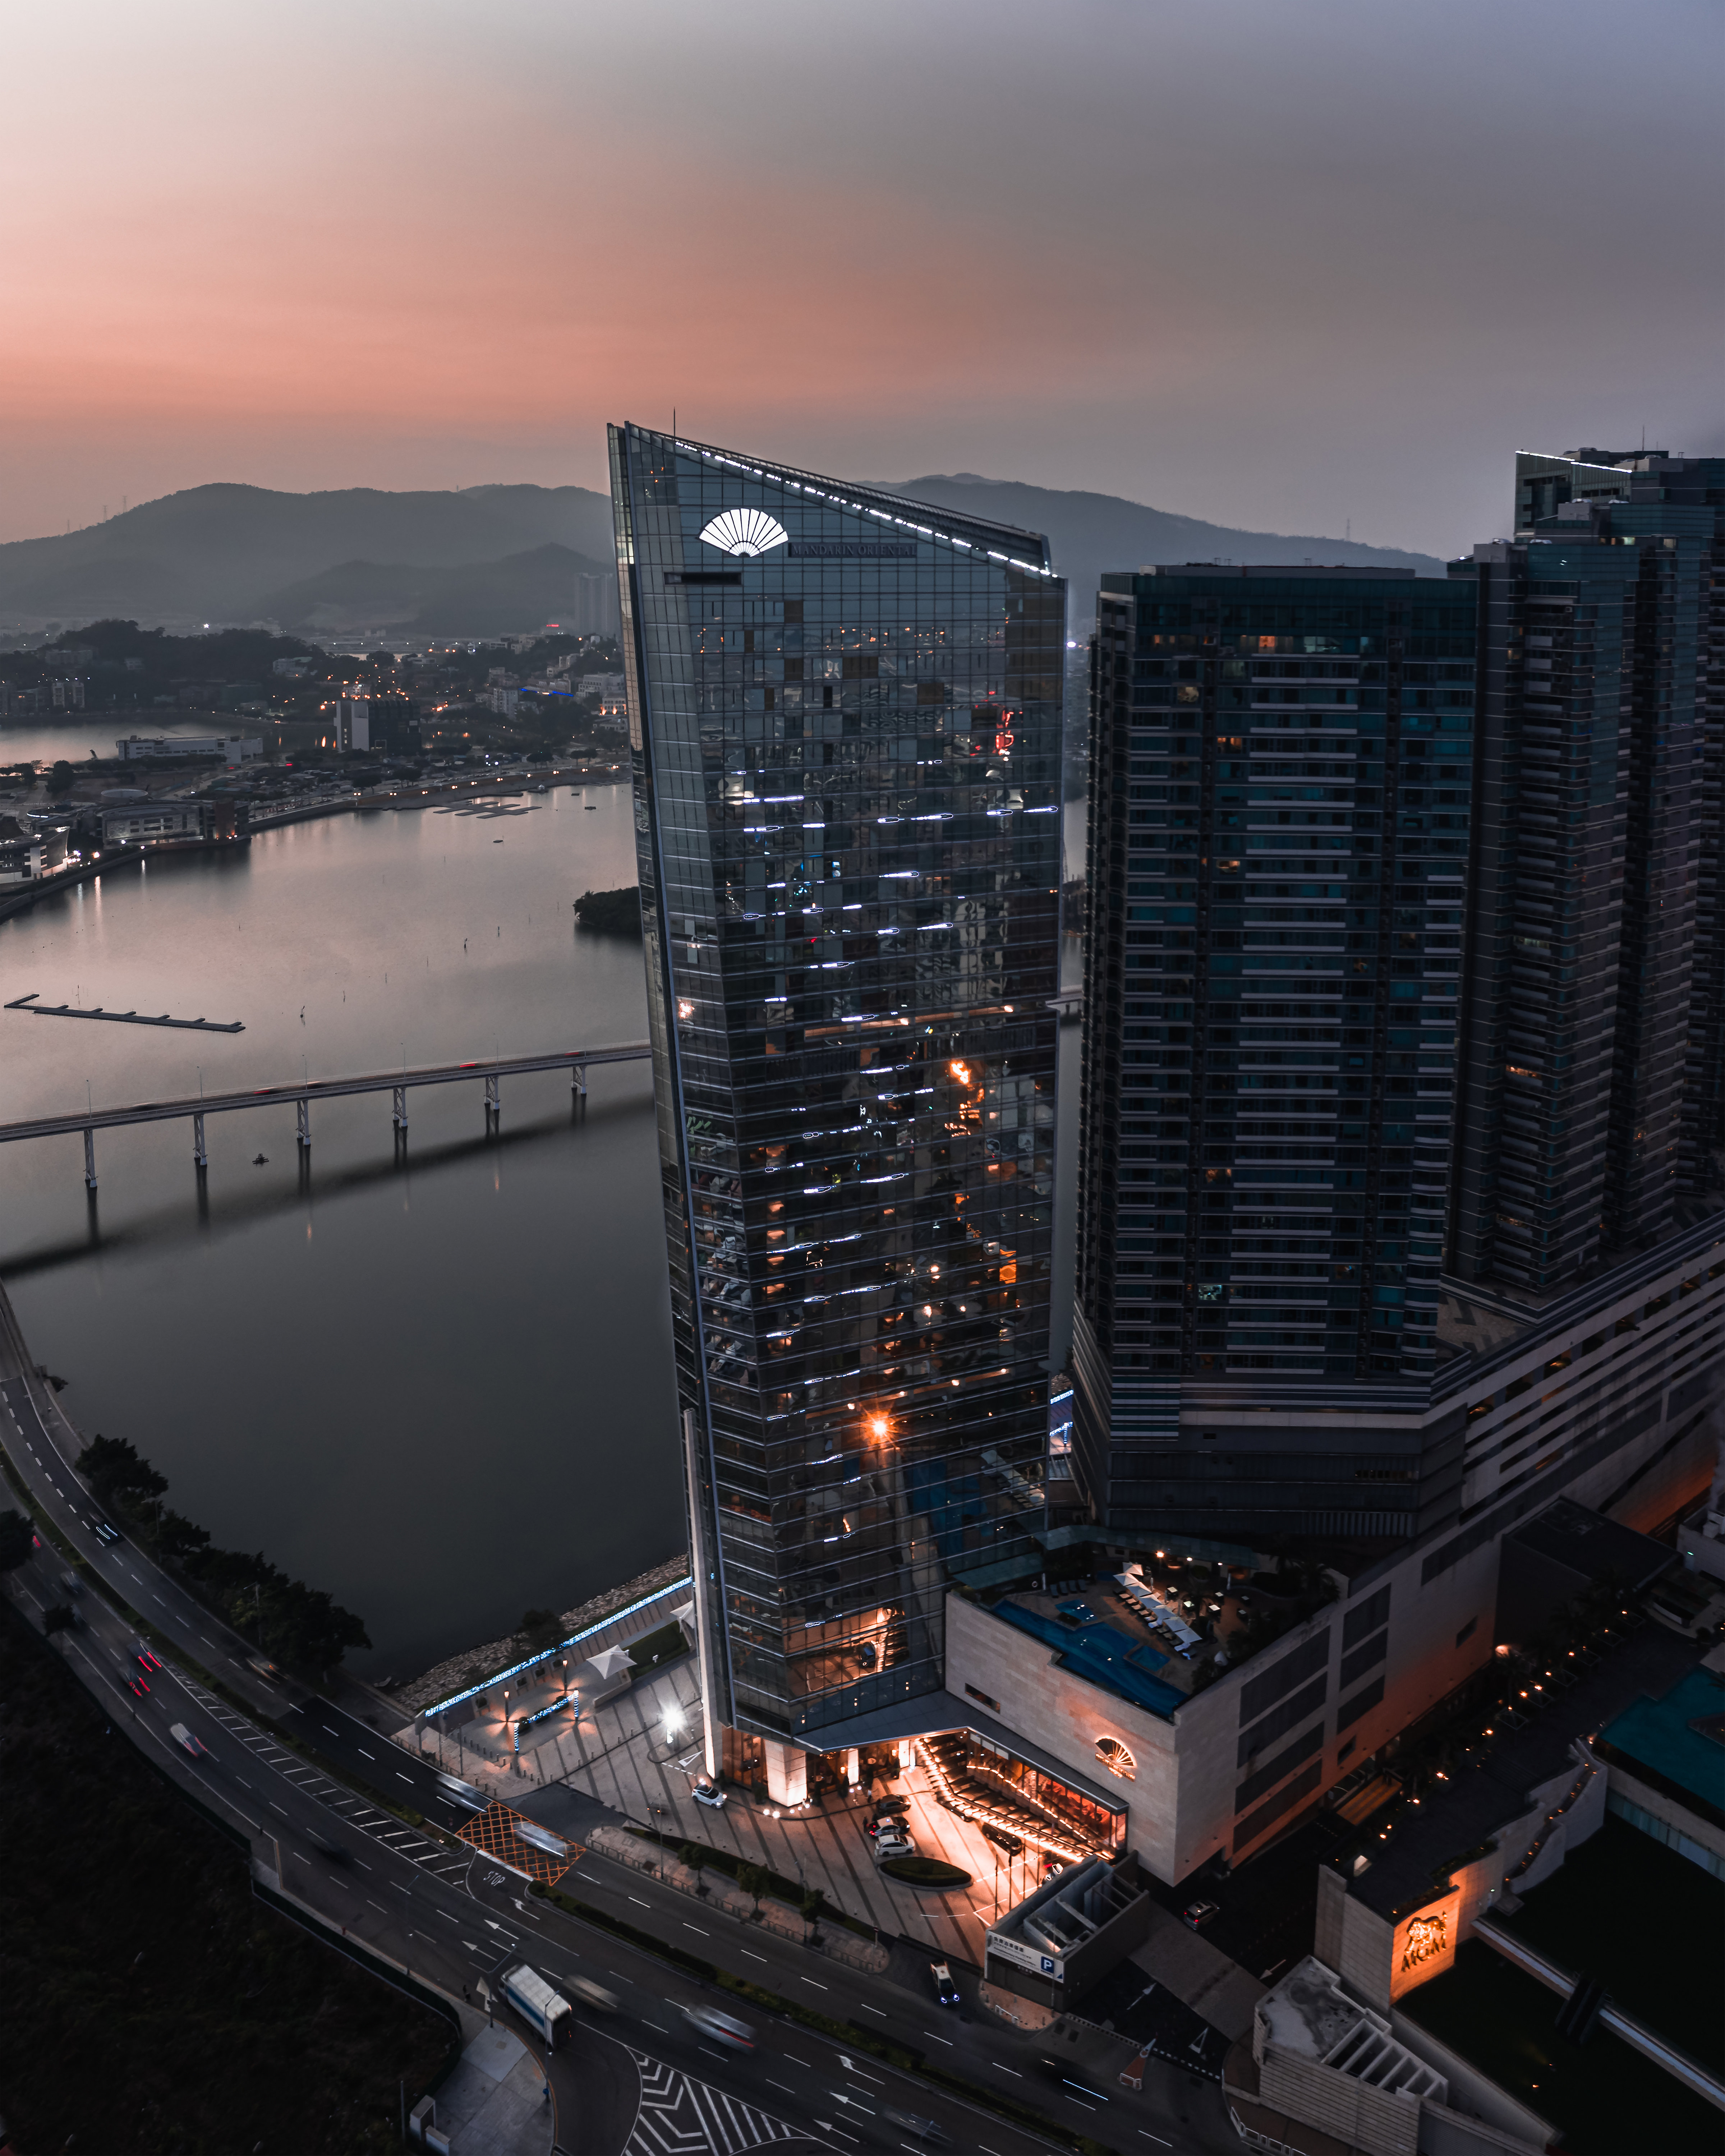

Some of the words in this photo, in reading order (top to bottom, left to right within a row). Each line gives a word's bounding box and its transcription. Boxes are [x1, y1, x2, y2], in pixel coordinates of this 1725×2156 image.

[793, 545, 854, 555] MANDARIN
[858, 545, 916, 555] ORIENTAL
[483, 1871, 505, 1886] STOP
[1044, 1959, 1052, 1969] P
